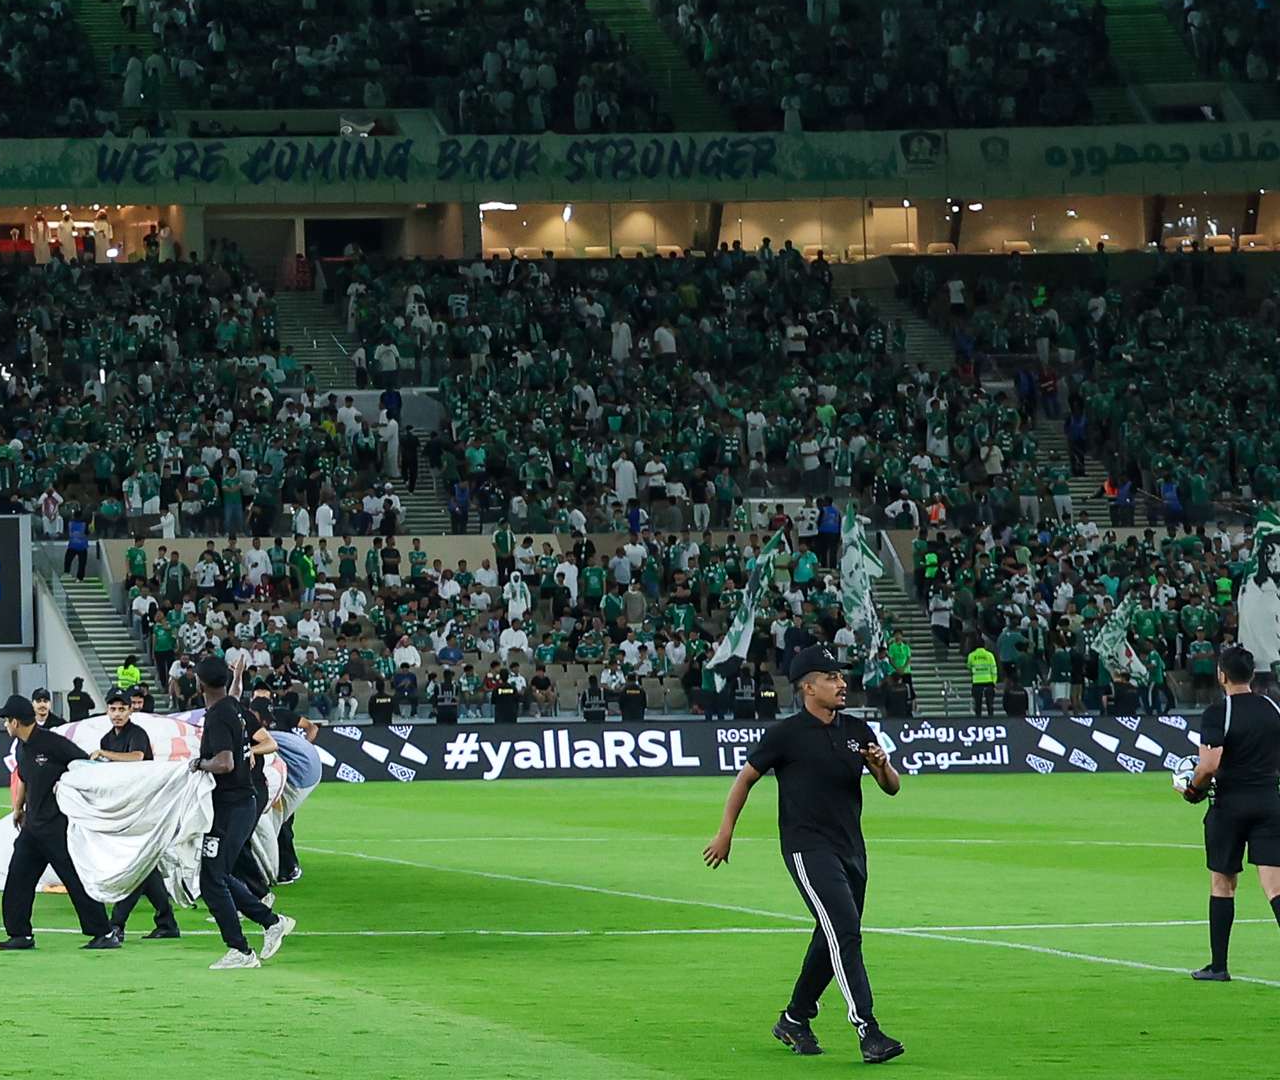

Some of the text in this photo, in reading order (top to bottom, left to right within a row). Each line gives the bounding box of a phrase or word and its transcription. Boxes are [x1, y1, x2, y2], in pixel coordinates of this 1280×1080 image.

[242, 137, 415, 184] COMING
[438, 138, 541, 182] BACK
[565, 135, 778, 182] STRONGER
[716, 728, 765, 743] ROSH
[899, 721, 1007, 747] دوري روشن
[444, 729, 701, 780] #yallaRSL
[902, 744, 1010, 775] السعودي
